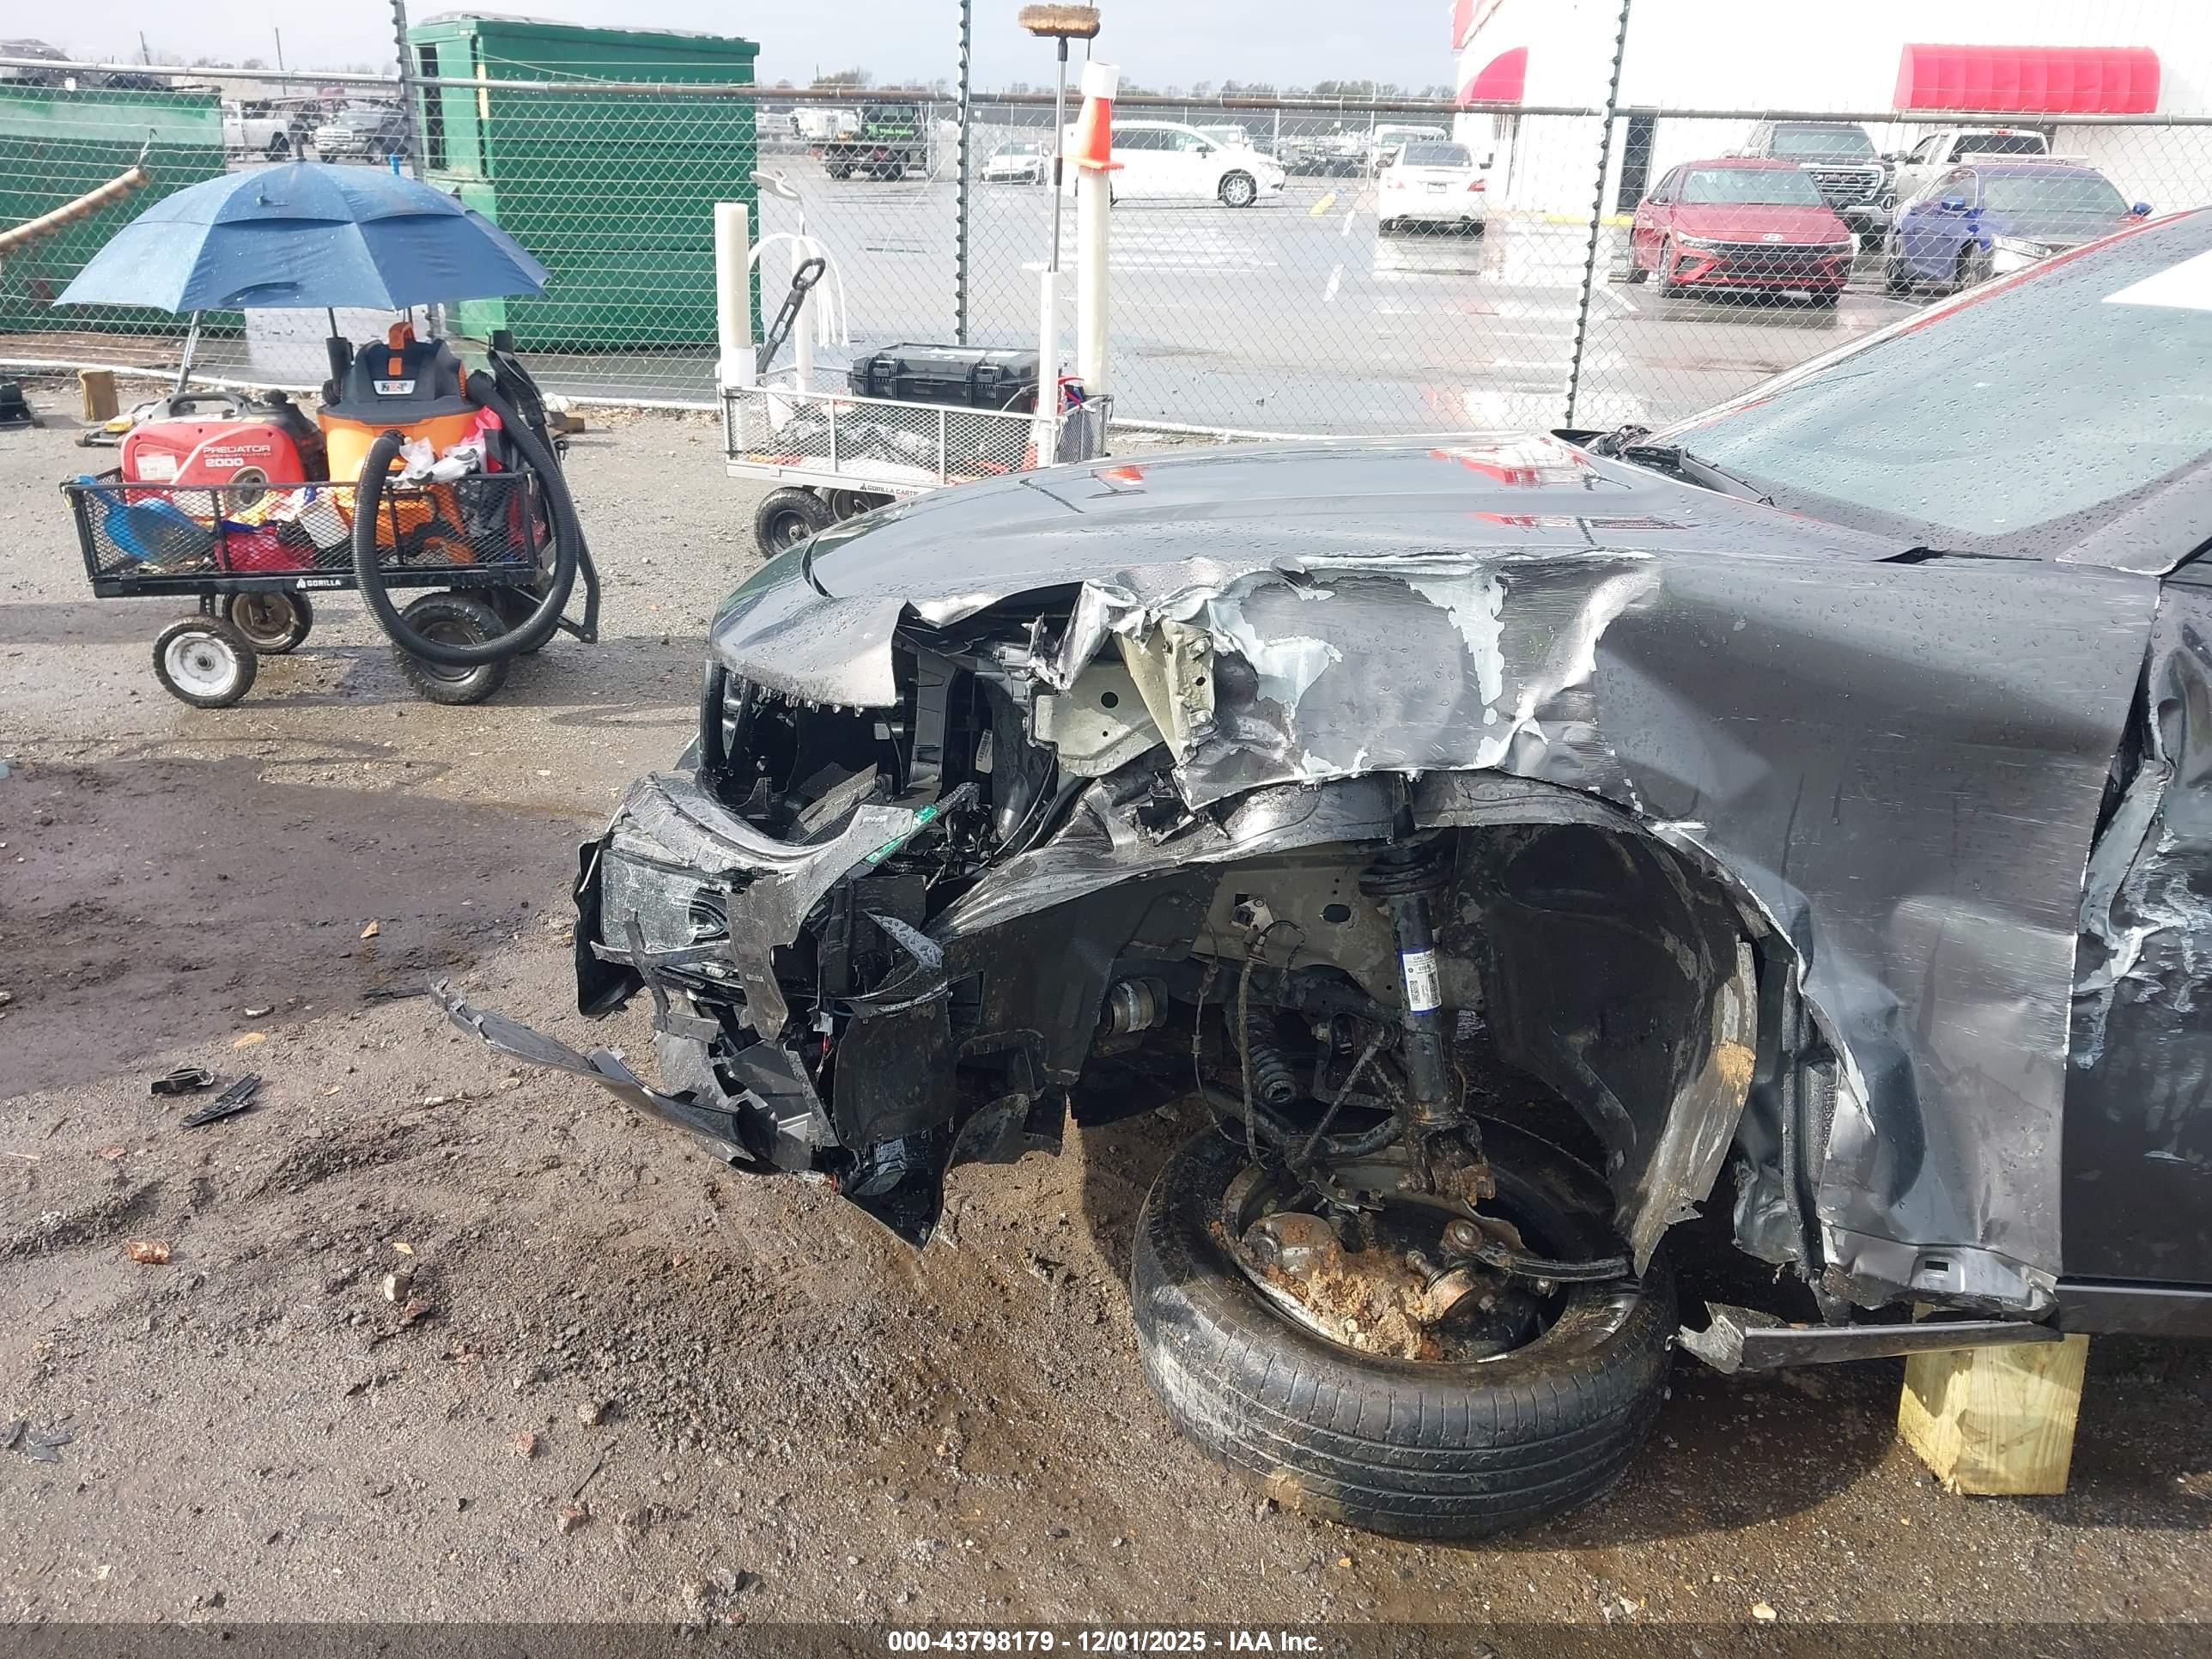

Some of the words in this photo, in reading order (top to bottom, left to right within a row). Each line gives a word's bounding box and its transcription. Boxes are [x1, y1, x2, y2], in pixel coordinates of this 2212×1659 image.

[203, 445, 270, 454] PREDATOR
[205, 457, 245, 467] 2000
[867, 484, 895, 494] GORILLA
[307, 579, 342, 587] GORILLA
